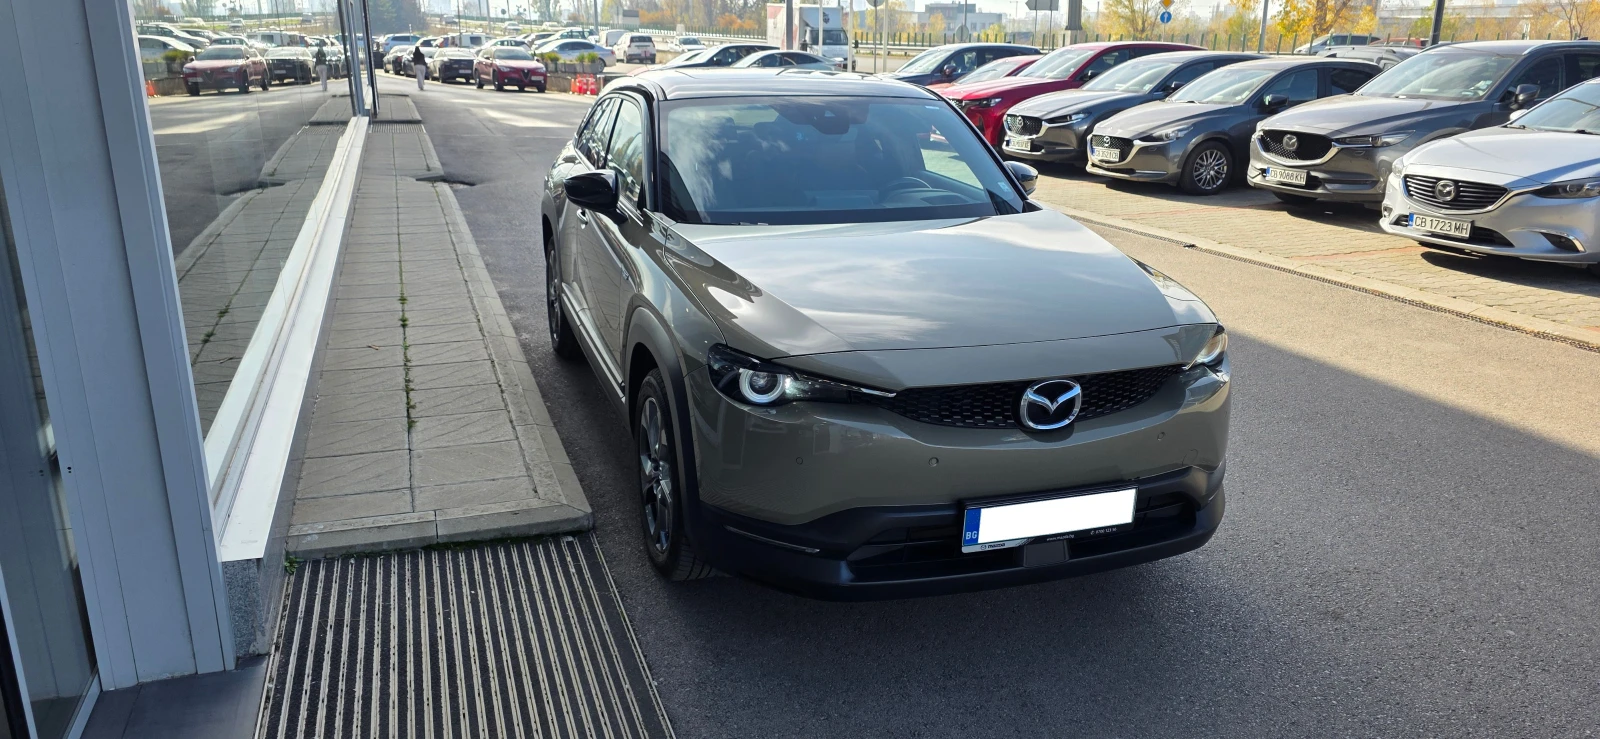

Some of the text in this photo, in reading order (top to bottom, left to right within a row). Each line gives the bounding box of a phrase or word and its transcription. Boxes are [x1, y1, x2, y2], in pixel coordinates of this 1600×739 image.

[1295, 172, 1306, 182] KH
[1415, 216, 1469, 235] CB 1723 MH
[965, 530, 978, 540] BG
